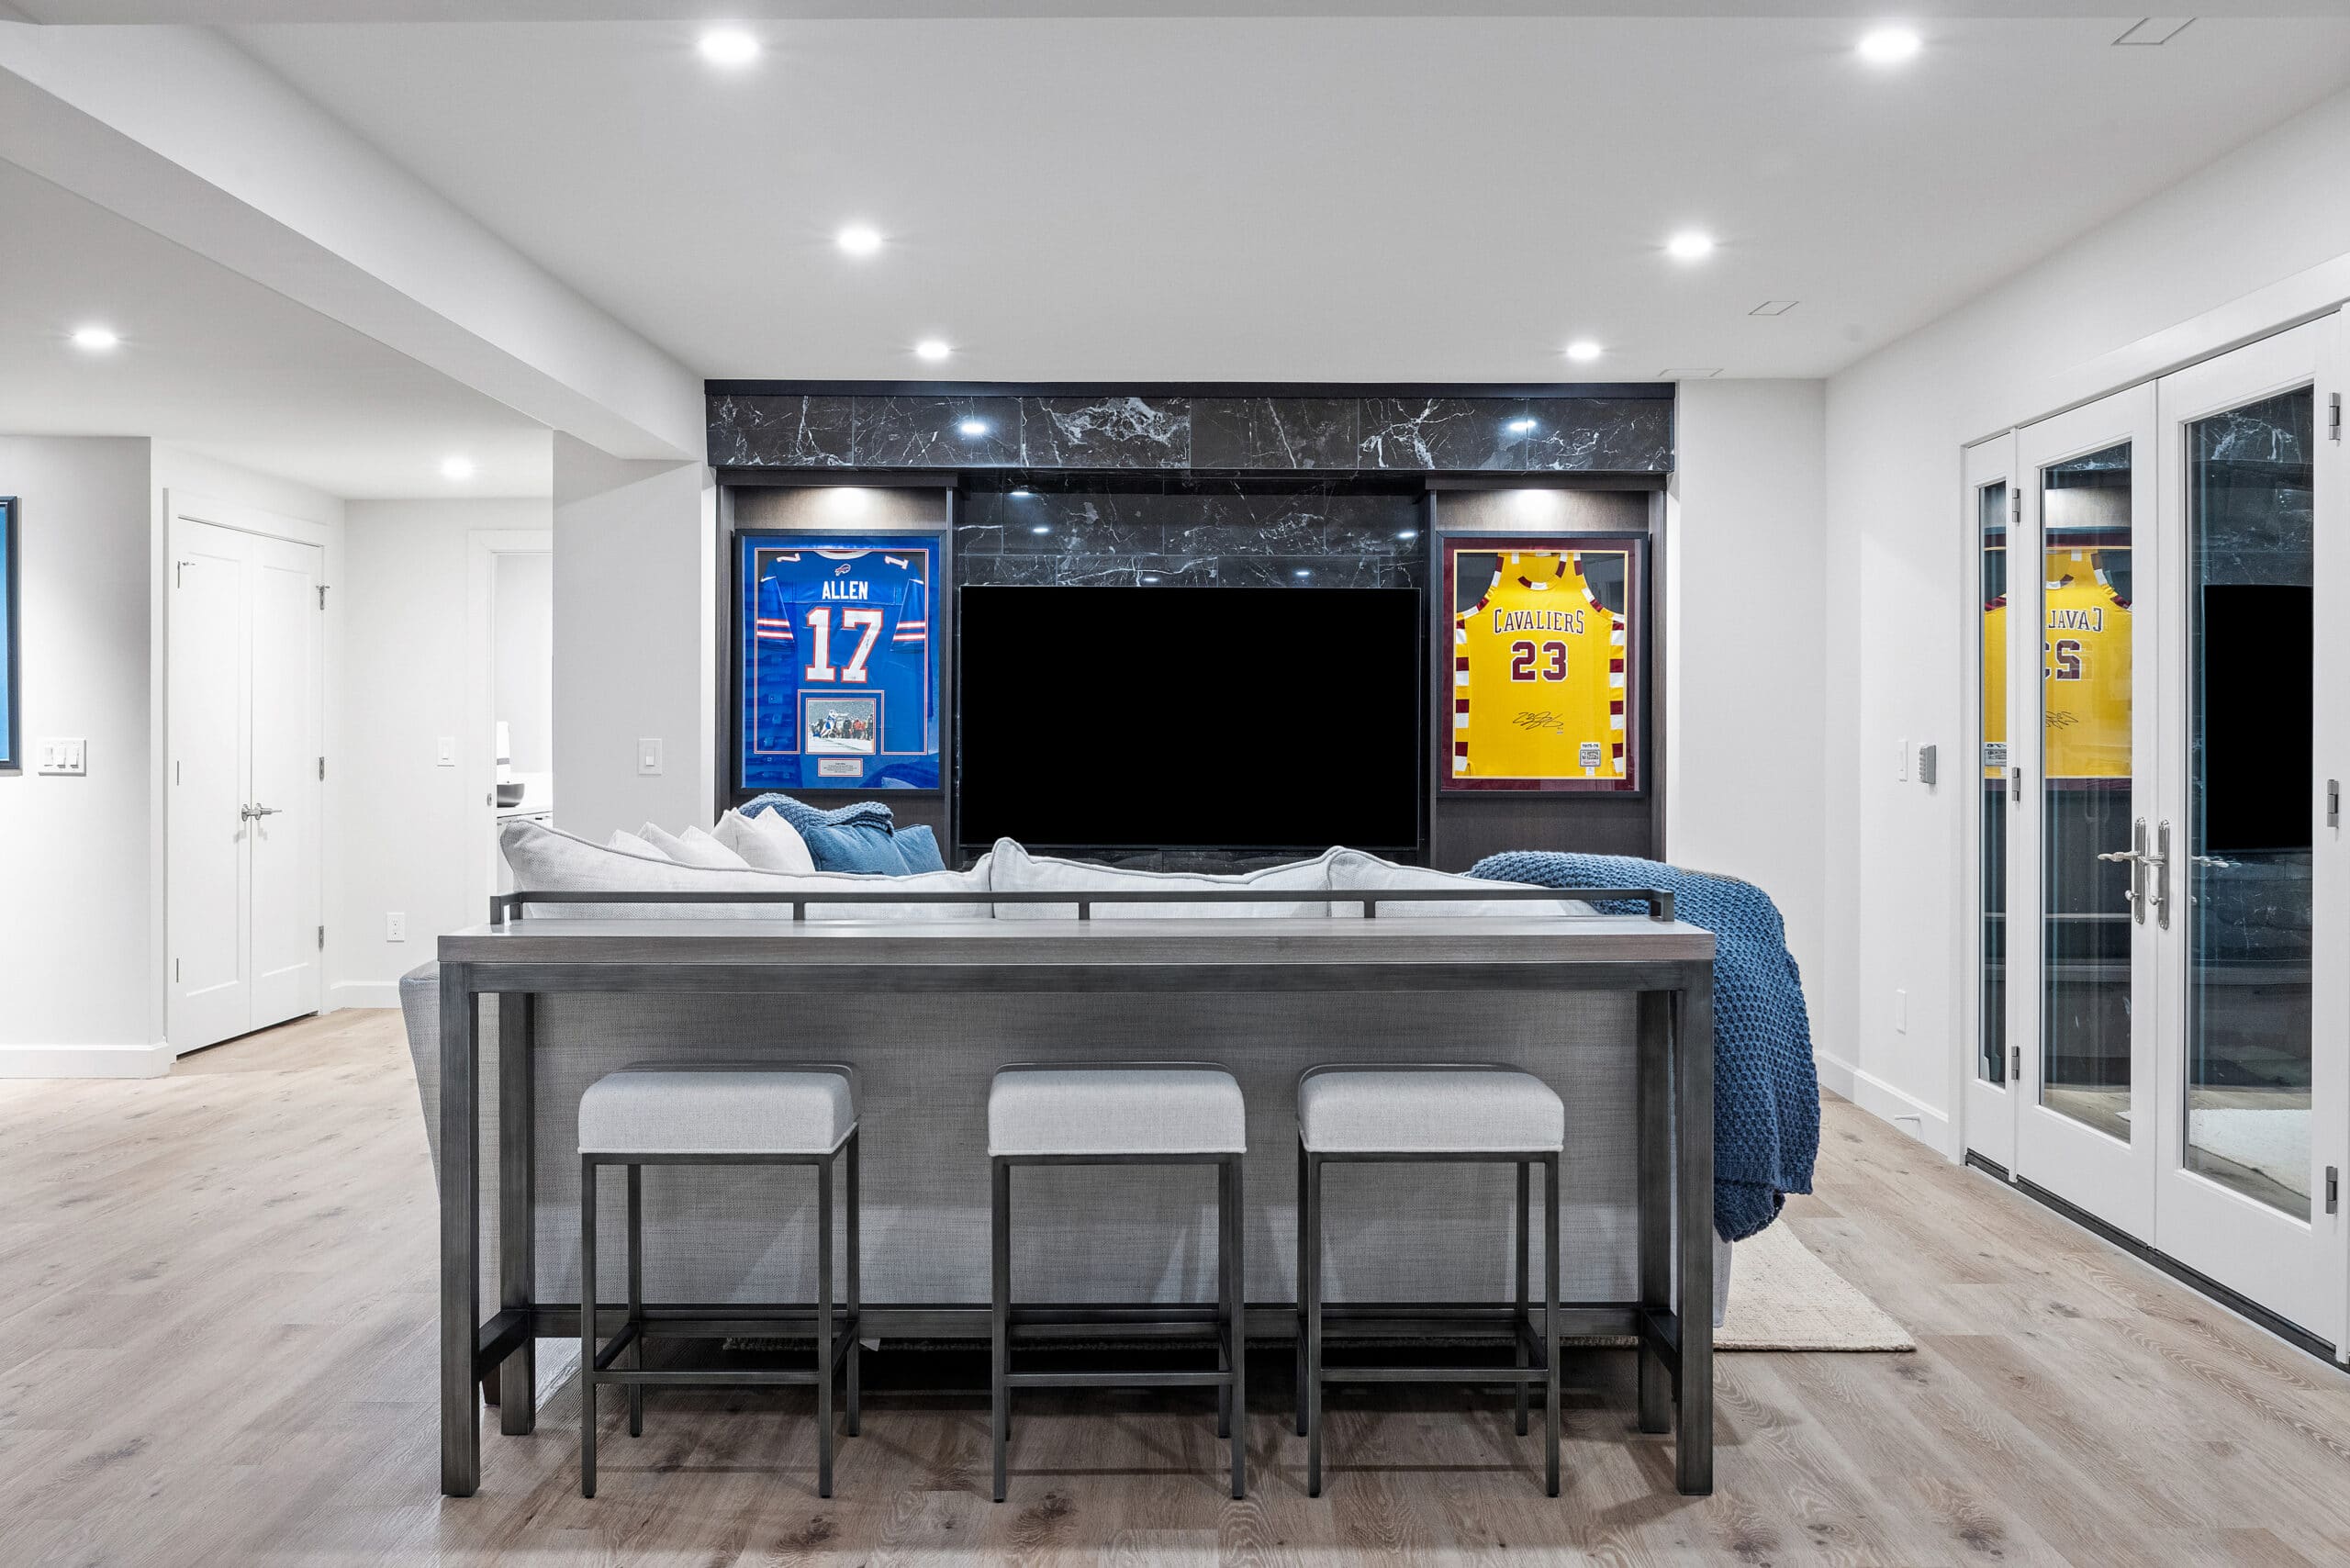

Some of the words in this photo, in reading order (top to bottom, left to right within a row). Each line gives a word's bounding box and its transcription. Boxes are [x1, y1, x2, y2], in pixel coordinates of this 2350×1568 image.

[822, 580, 868, 600] ALLEN
[1494, 608, 1584, 634] CAVALIERS
[805, 607, 884, 683] 17
[1511, 640, 1568, 682] 23
